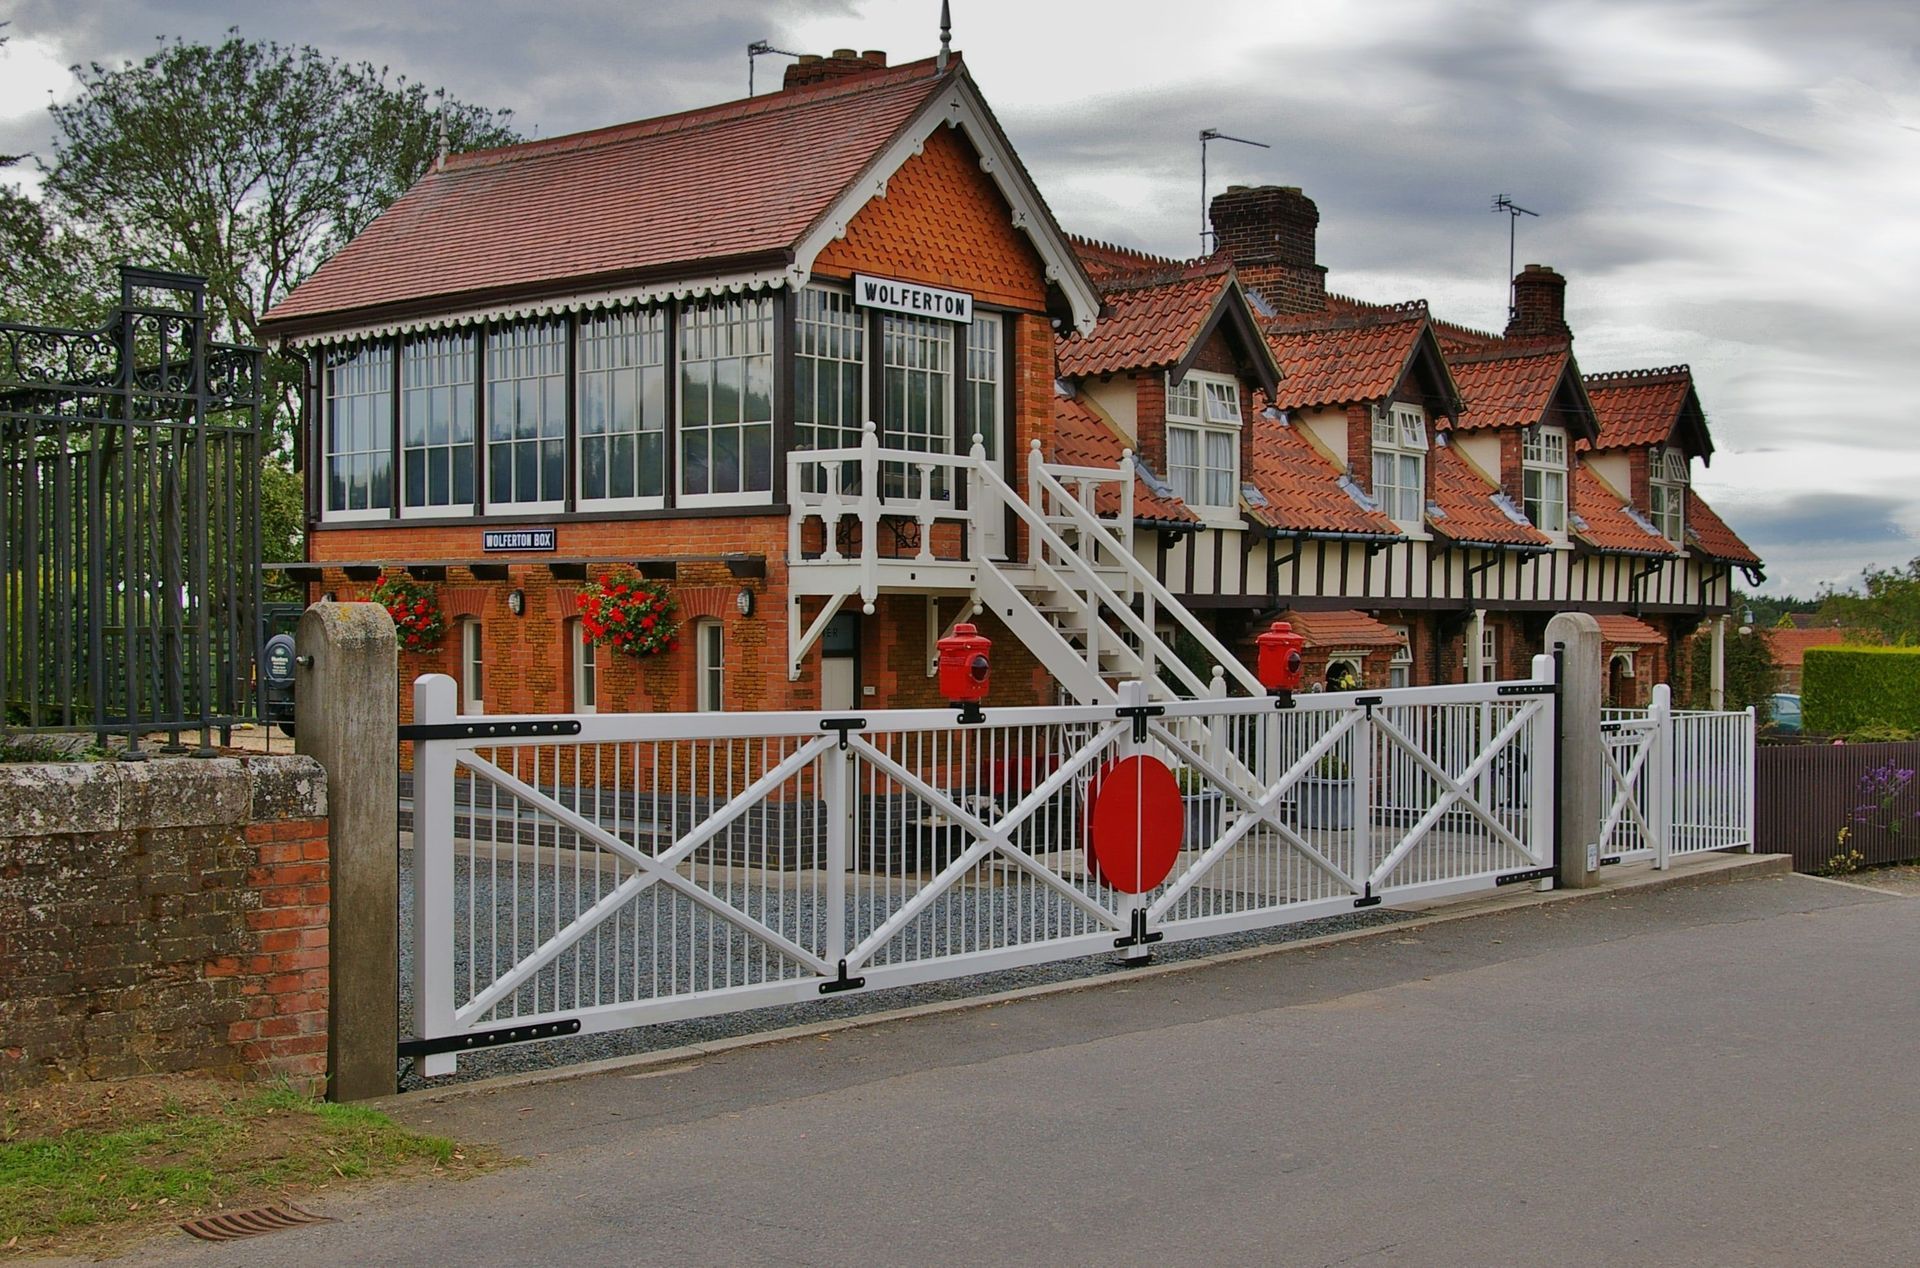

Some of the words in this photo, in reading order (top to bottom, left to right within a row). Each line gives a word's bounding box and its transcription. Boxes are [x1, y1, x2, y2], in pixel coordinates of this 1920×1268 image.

[864, 282, 965, 316] WOLFERTON
[486, 533, 532, 548] WOLFERTON
[533, 533, 551, 547] BOX
